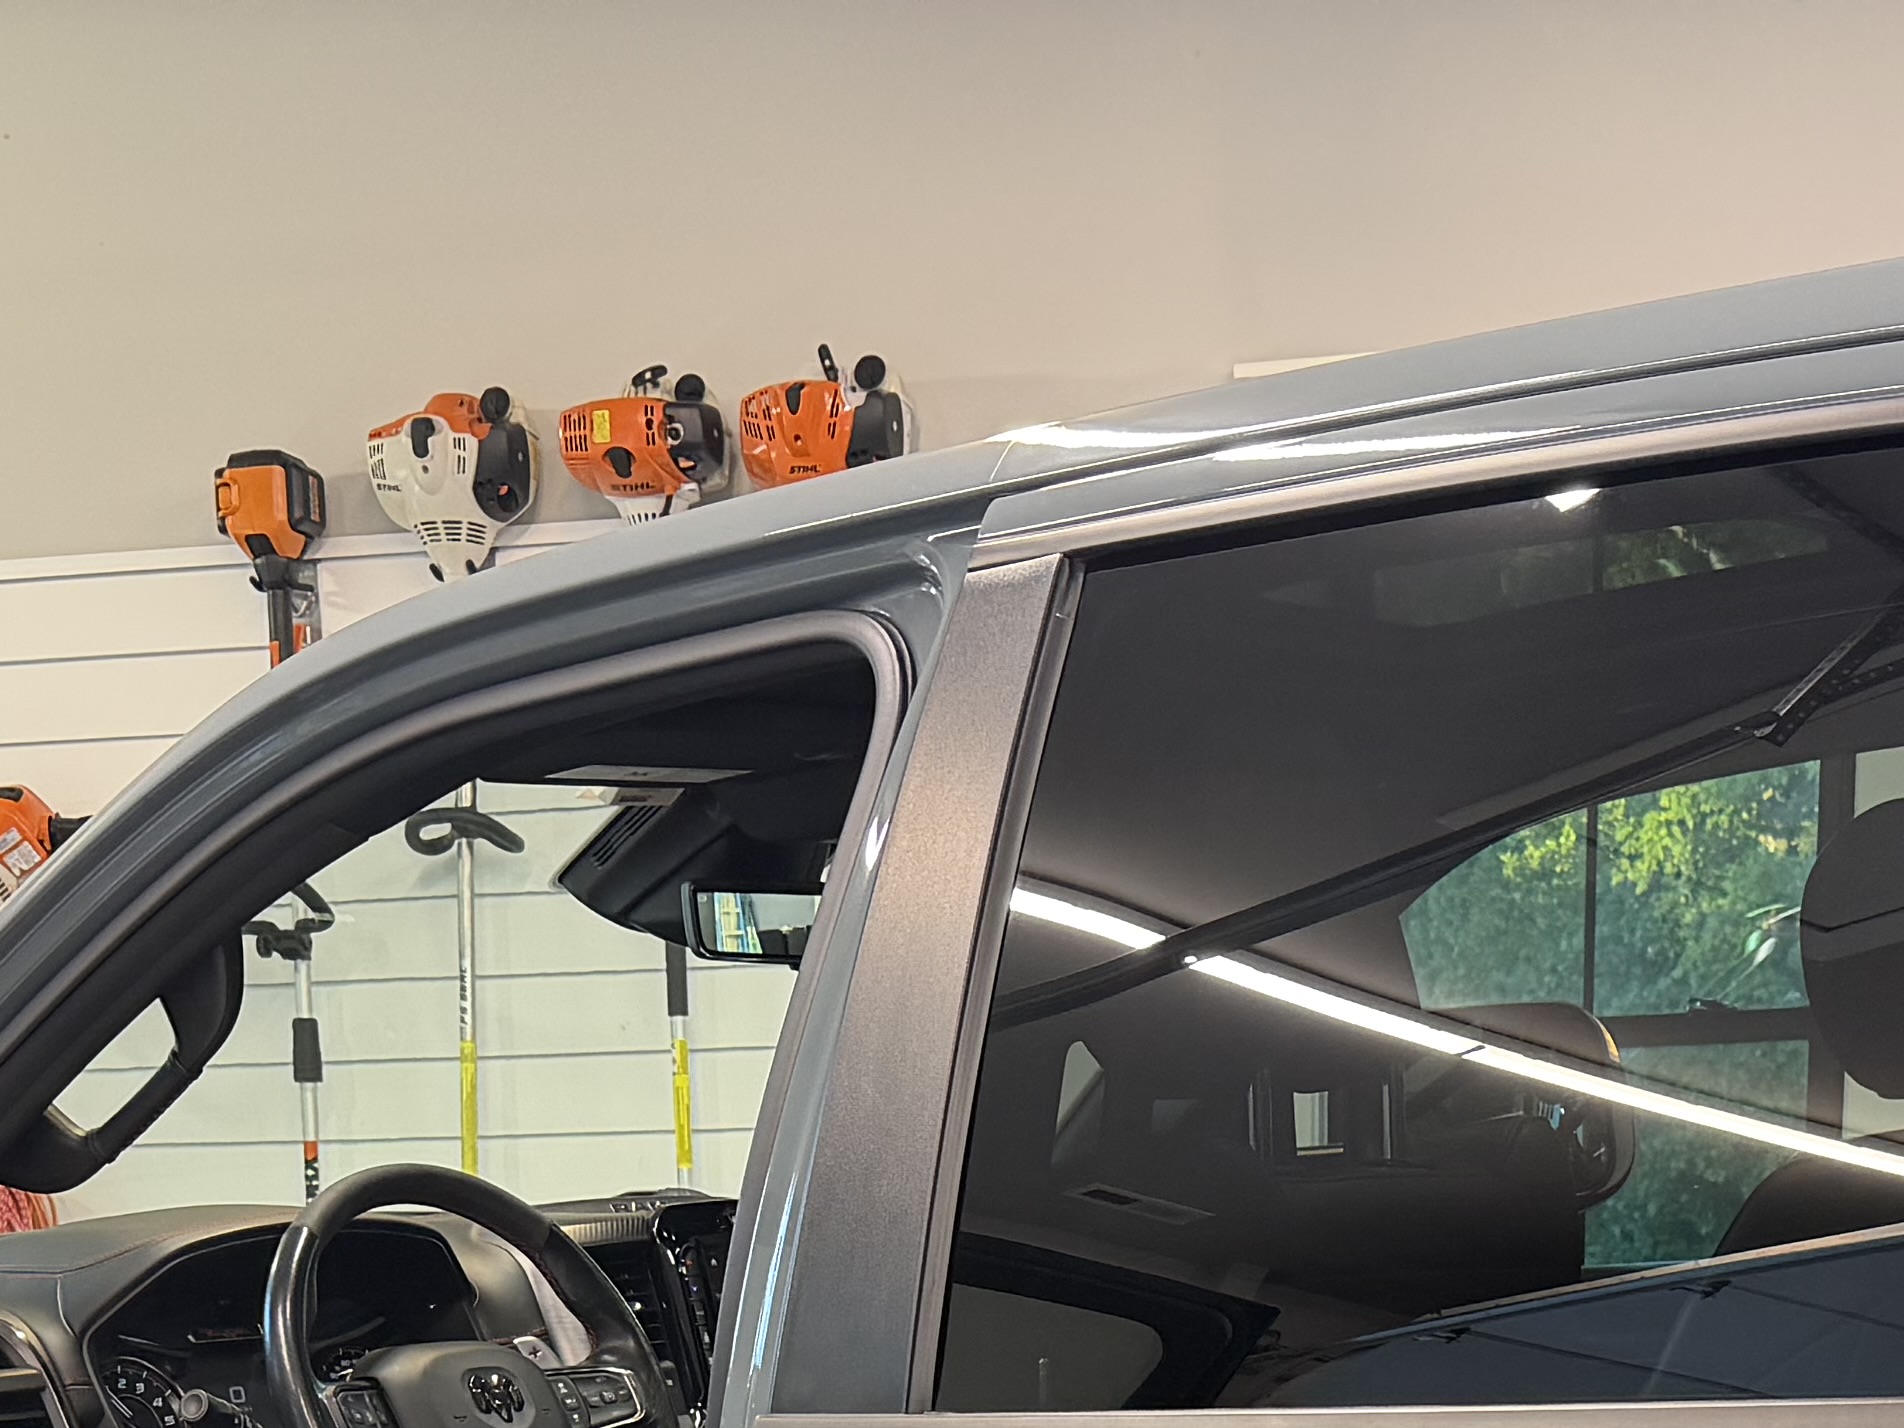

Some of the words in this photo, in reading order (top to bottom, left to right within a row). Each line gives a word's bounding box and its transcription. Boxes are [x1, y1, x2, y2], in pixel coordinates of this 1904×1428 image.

[789, 465, 820, 474] STIHL
[117, 1379, 127, 1389] 2
[135, 1382, 145, 1394] 3
[152, 1397, 163, 1407] 4
[164, 1415, 176, 1426] 5
